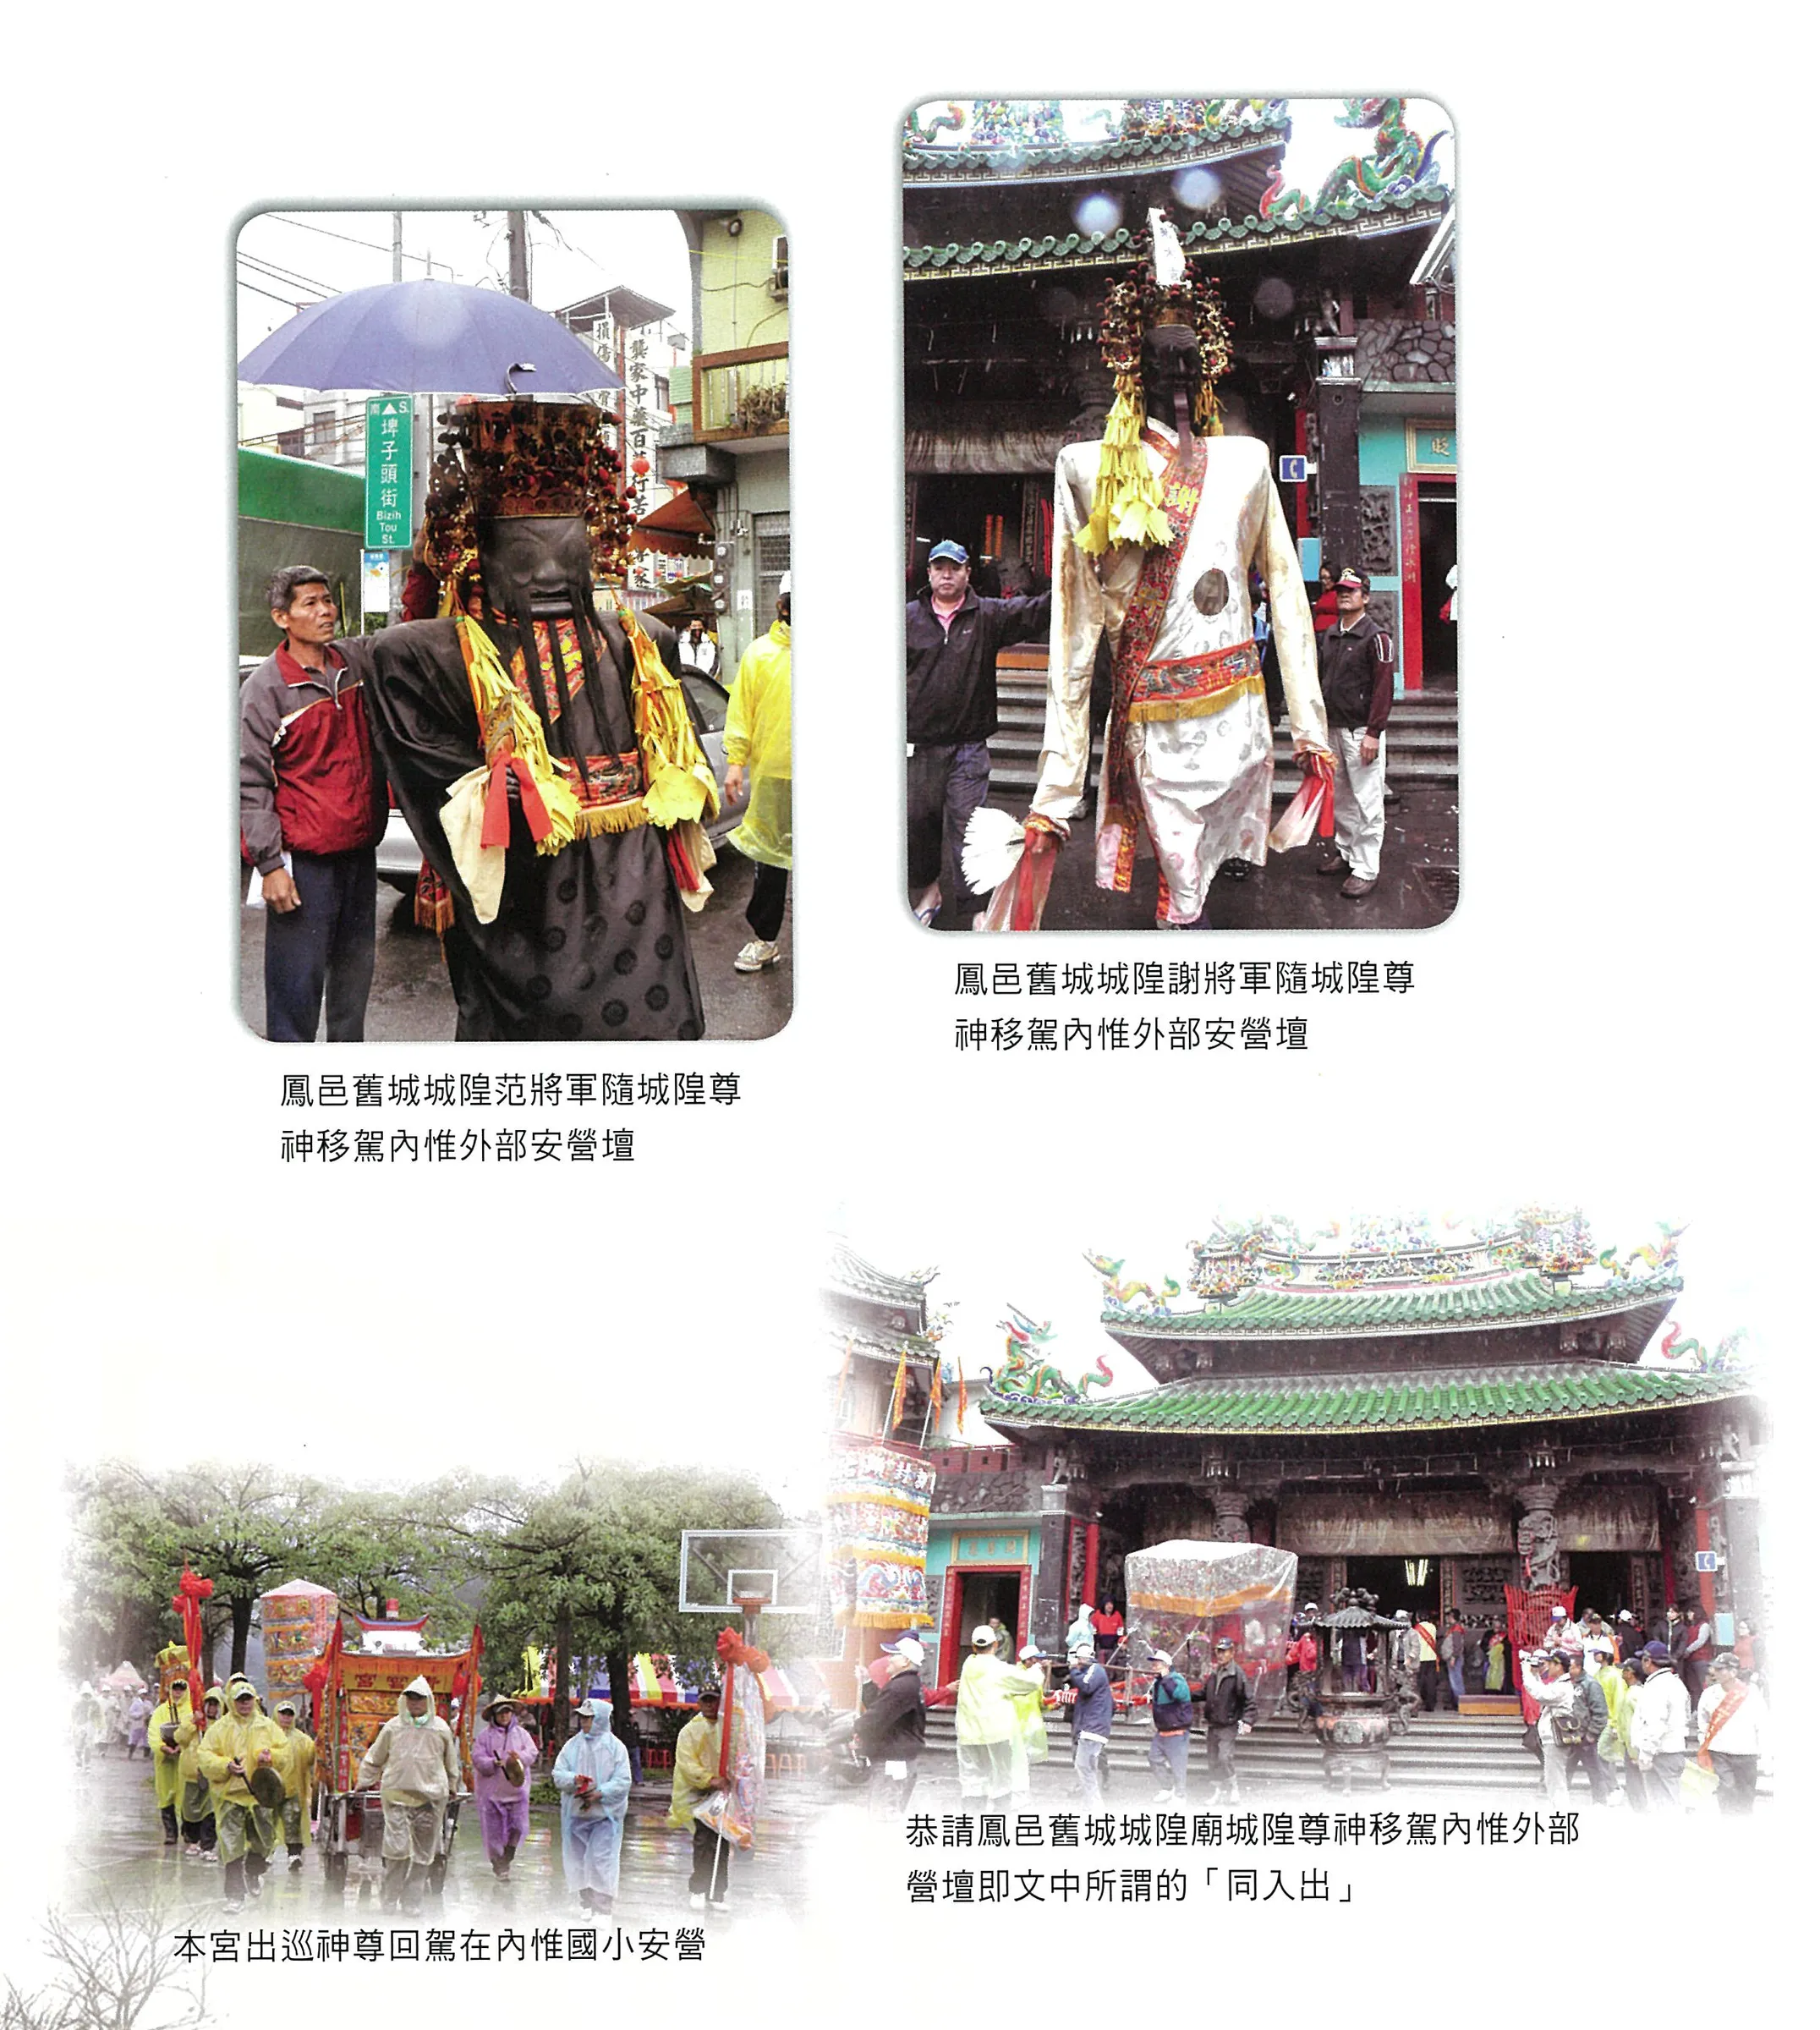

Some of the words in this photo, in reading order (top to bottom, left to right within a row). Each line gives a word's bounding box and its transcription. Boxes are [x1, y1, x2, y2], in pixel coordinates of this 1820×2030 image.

[381, 417, 398, 508] 埤子頭街
[376, 510, 402, 521] Bizih
[379, 522, 397, 533] Tou
[381, 534, 395, 544] St.
